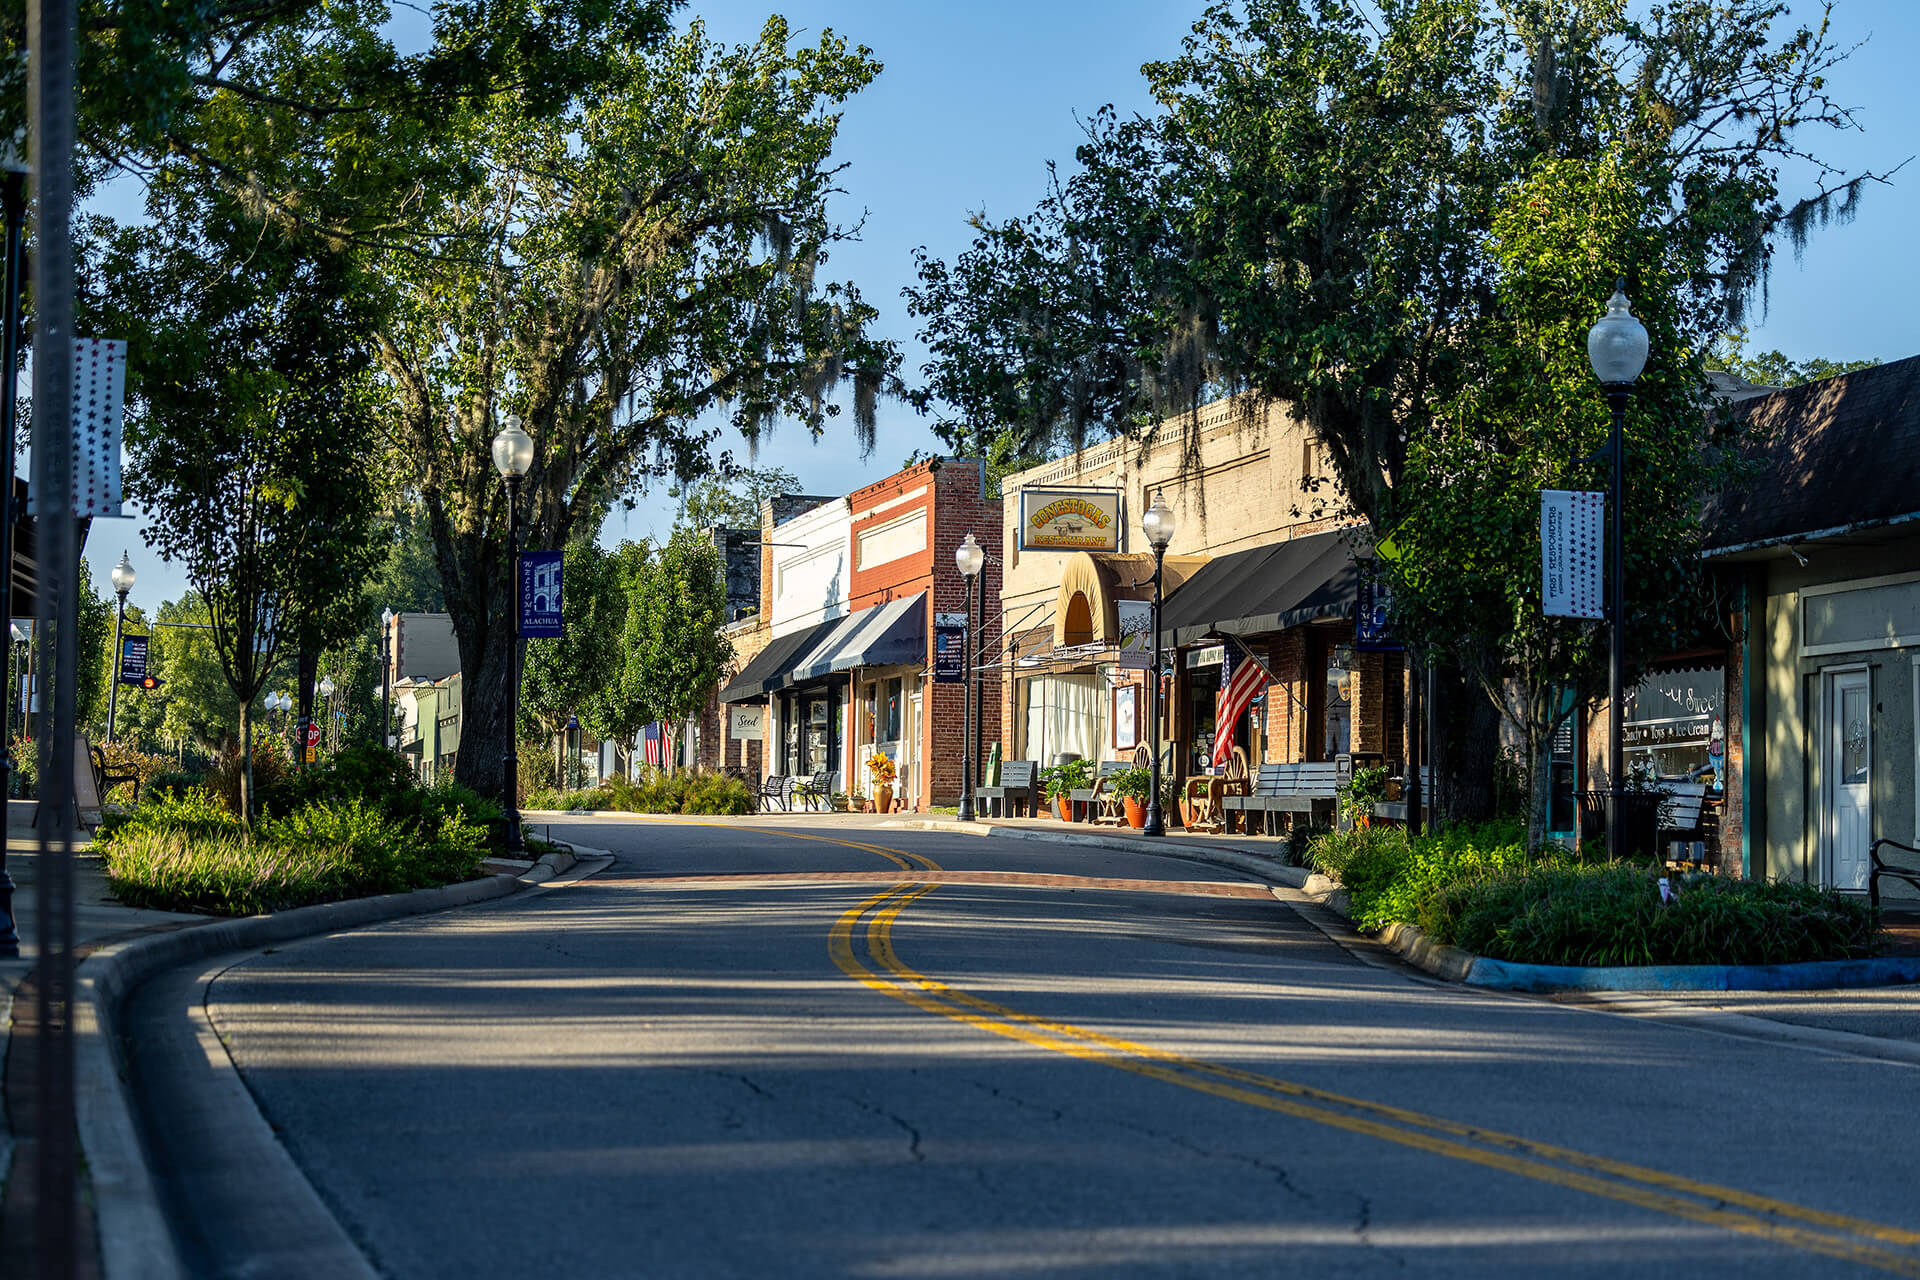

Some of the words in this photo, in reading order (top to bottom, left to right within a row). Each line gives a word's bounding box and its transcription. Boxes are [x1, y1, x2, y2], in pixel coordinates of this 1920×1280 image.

[1031, 498, 1111, 529] CONESTOGAS
[1034, 535, 1107, 546] RESTAURANT
[1549, 506, 1557, 569] RESPONDERS
[523, 561, 533, 616] WELCOME
[1549, 573, 1557, 598] FIRST
[738, 714, 758, 728] Seed
[1650, 725, 1665, 743] Toys
[1675, 723, 1687, 737] Ice
[1688, 721, 1710, 736] Cream
